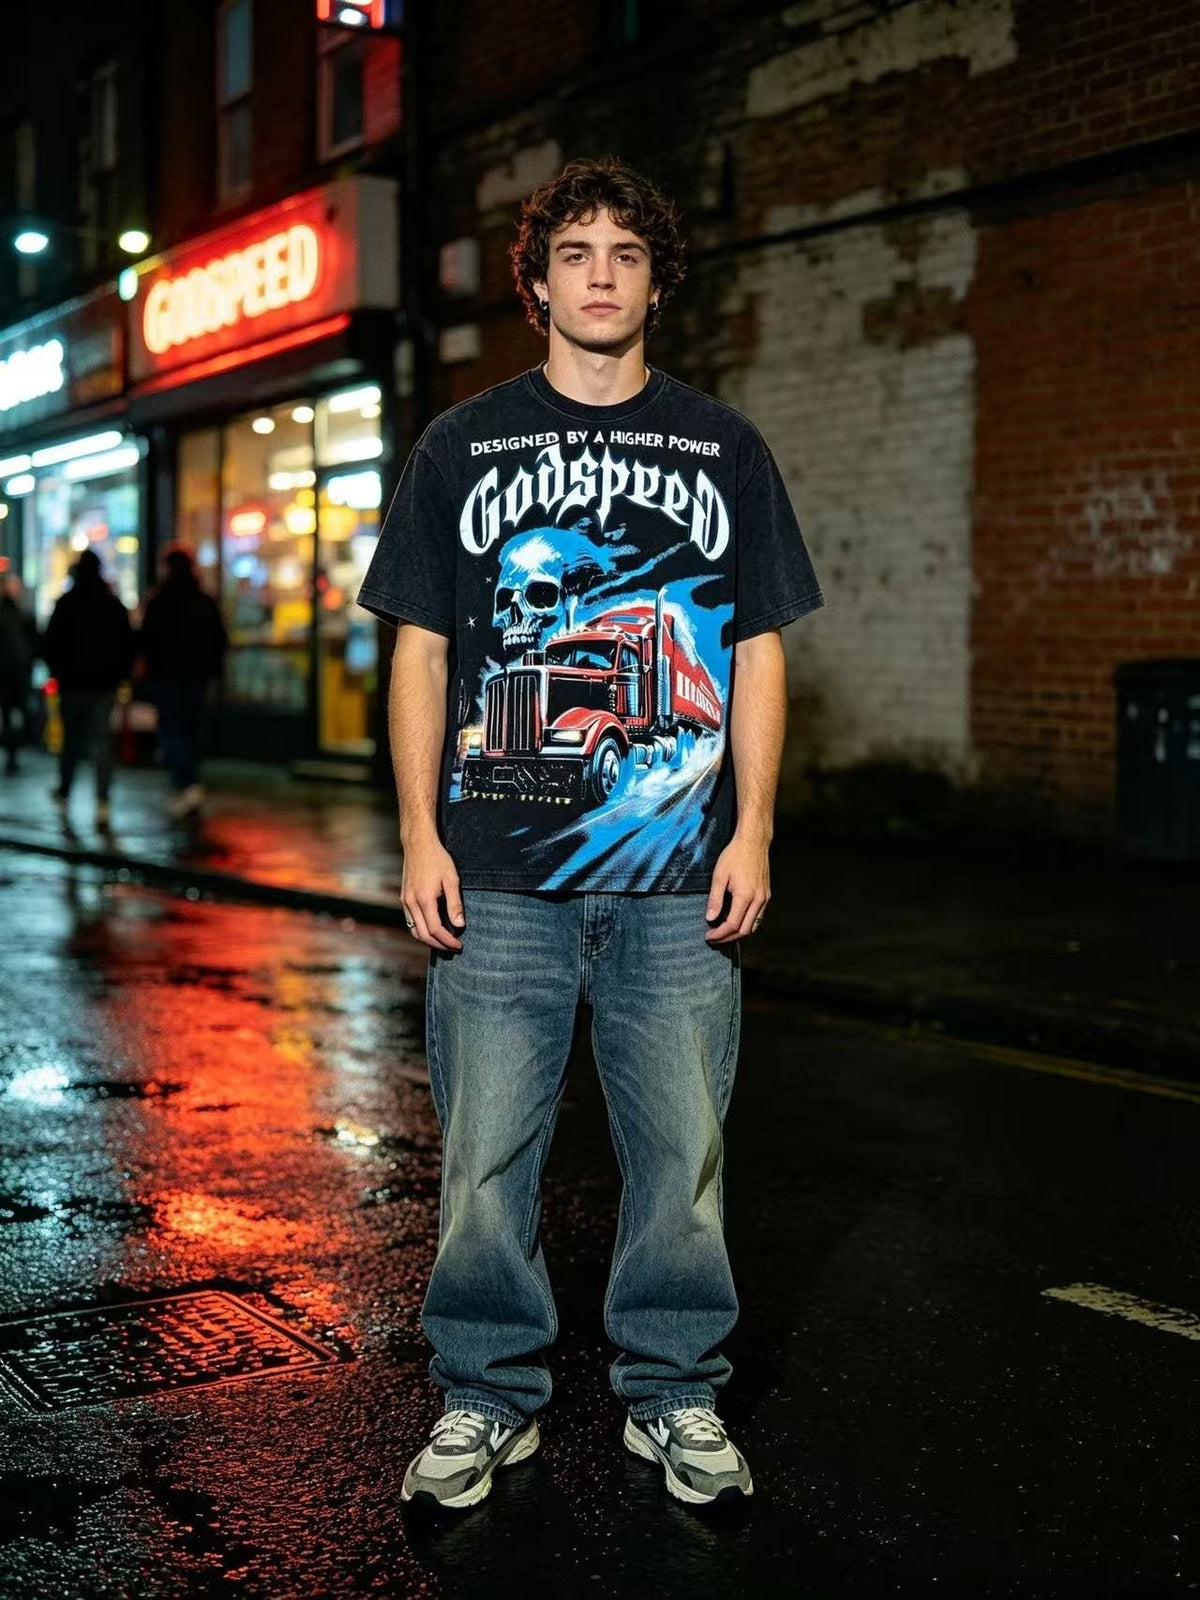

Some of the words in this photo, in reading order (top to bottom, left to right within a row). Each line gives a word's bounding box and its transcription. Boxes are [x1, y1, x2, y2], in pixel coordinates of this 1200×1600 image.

[470, 432, 560, 456] DESIGNED
[566, 430, 588, 444] BY
[593, 430, 605, 443] A
[610, 431, 663, 447] HIGHER
[668, 435, 721, 457] POWER
